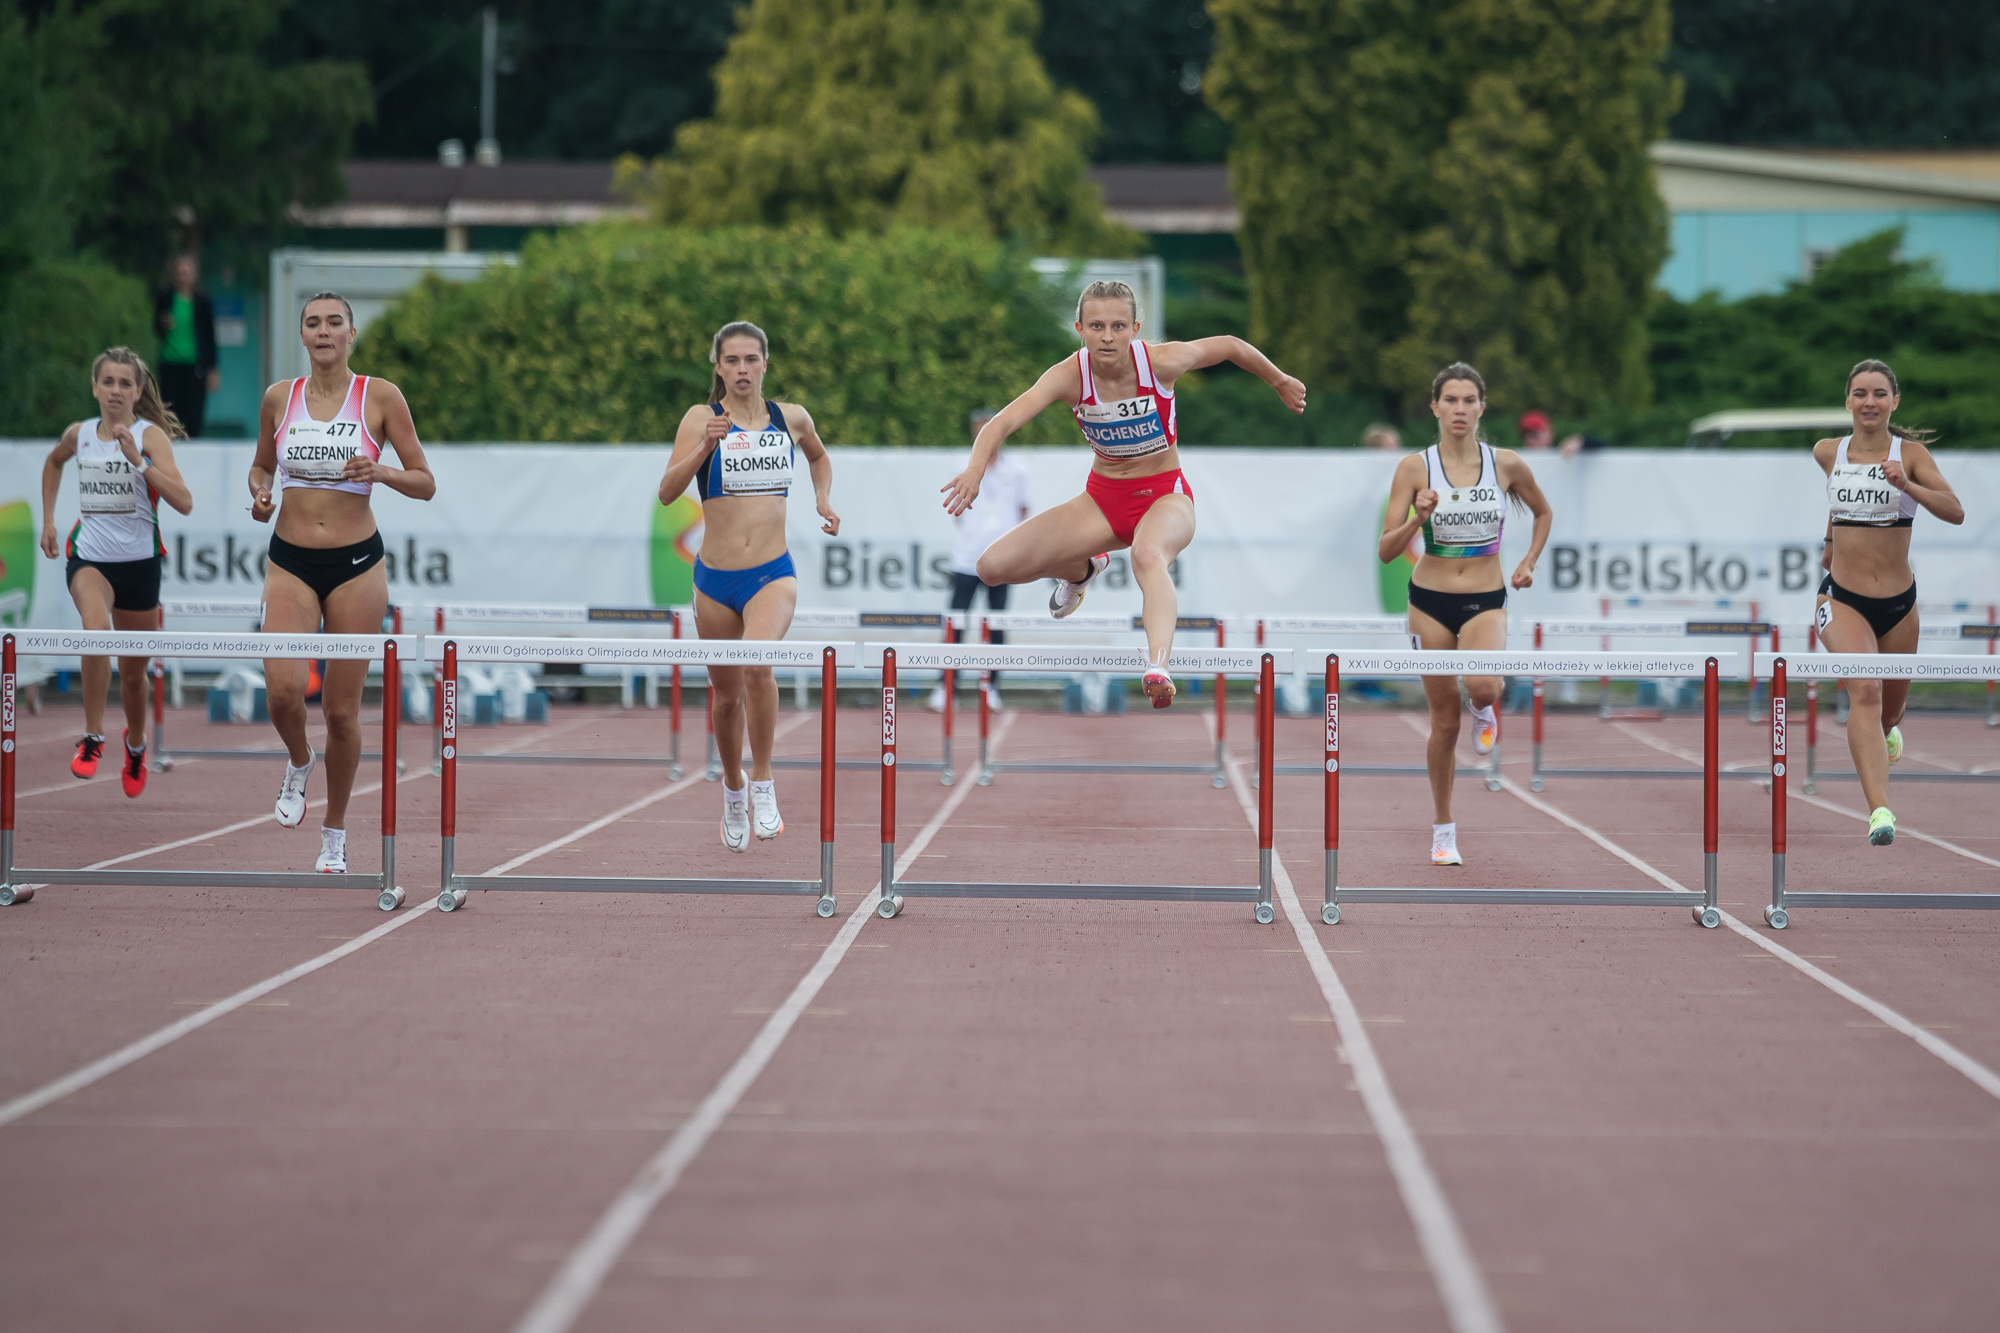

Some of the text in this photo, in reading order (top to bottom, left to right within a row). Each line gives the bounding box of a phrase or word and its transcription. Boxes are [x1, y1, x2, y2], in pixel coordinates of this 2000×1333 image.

[1117, 398, 1150, 417] 317
[326, 423, 357, 436] 477
[1084, 419, 1160, 441] SUCHENEK
[759, 434, 784, 447] 627
[287, 446, 358, 461] SZCZEPANIK
[105, 462, 131, 474] 371
[725, 456, 789, 472] SŁOMSKA
[1469, 489, 1496, 502] 302
[1837, 489, 1890, 504] GLATKI
[1433, 510, 1499, 526] CHODKOWSKA
[1818, 607, 1828, 627] 3
[27, 638, 375, 654] XXVIII Ogólnopolska Olimpiada Młodzieży w lekkiej atletyce
[468, 645, 499, 655] XXVIII
[503, 645, 583, 657] Ogólnopolska
[588, 646, 648, 659] Olimpiada
[653, 648, 709, 660] Młodzieży
[727, 649, 762, 661] lekkiej
[766, 649, 814, 661] atletyce
[908, 655, 939, 665] XXVIII
[944, 655, 1023, 667] Ogólnopolska
[1028, 655, 1088, 667] Olimpiada
[1169, 657, 1201, 668] ekkiej
[1205, 656, 1253, 668] atletyce
[1349, 660, 1379, 669] XXVIII
[1384, 660, 1464, 671] Ogólnopolska
[1468, 660, 1528, 672] Olimpiada
[1533, 661, 1590, 672] Młodzieży
[1607, 661, 1642, 673] lekkiej
[1646, 661, 1694, 673] atletyce
[1796, 664, 1827, 674] XXVIII
[1832, 664, 1912, 676] Ogólnopolska
[1917, 664, 1978, 676] Olimpiada
[4, 675, 13, 727] POLANIK
[445, 682, 454, 733] POLANIK
[885, 689, 893, 740] POLANIK
[1328, 696, 1337, 746] POLANIK
[1775, 699, 1784, 750] POLANIK
